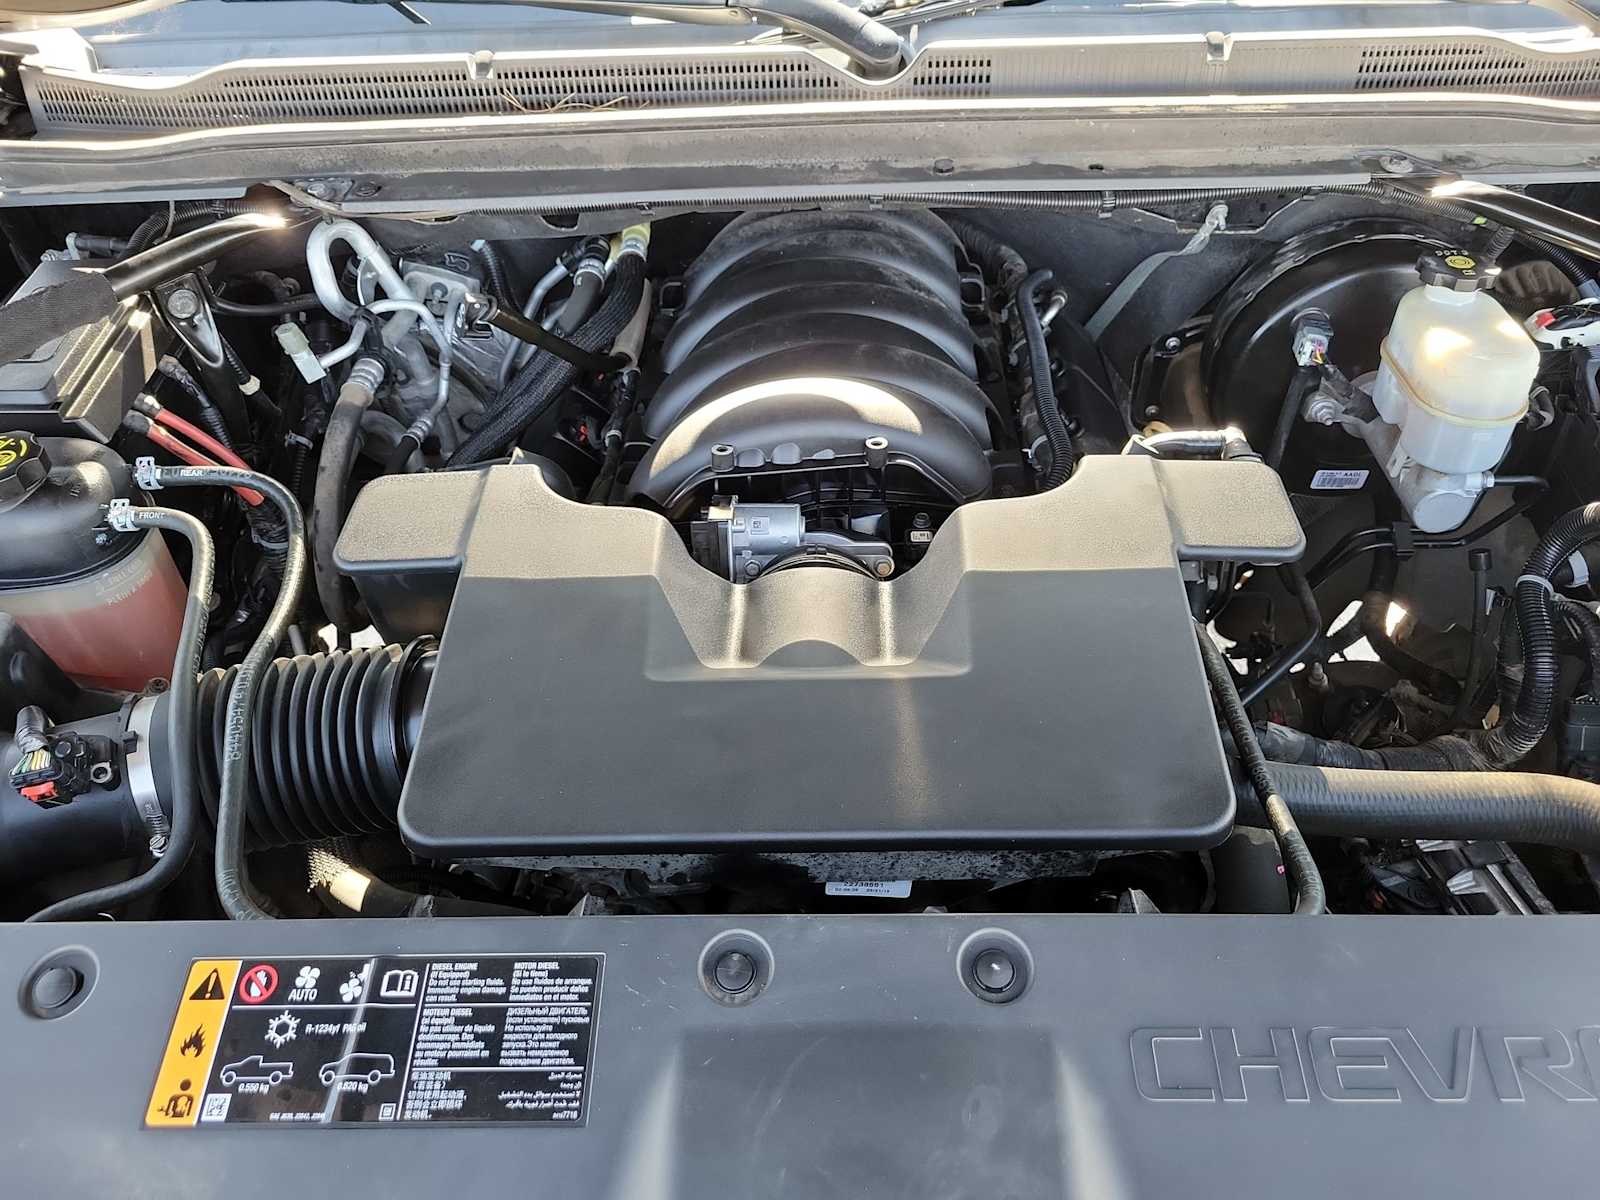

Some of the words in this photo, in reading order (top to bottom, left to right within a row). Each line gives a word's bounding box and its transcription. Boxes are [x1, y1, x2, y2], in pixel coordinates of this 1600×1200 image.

[180, 469, 203, 477] REAR
[139, 511, 166, 519] FRONT
[288, 988, 318, 1001] AUTO
[460, 987, 481, 995] engine
[451, 1008, 473, 1016] DIESEL
[507, 1007, 549, 1016] ДИЗЕЛЬНЫЙ
[549, 1008, 588, 1016] ДВИГАТЕЛЬ
[305, 1023, 341, 1035] R-1234yf
[515, 1024, 553, 1032] используйте
[447, 1050, 480, 1059] pourraient
[541, 1058, 575, 1066] двигателя.
[238, 1082, 259, 1094] 0.550
[260, 1083, 269, 1094] kg
[358, 1083, 369, 1094] kg
